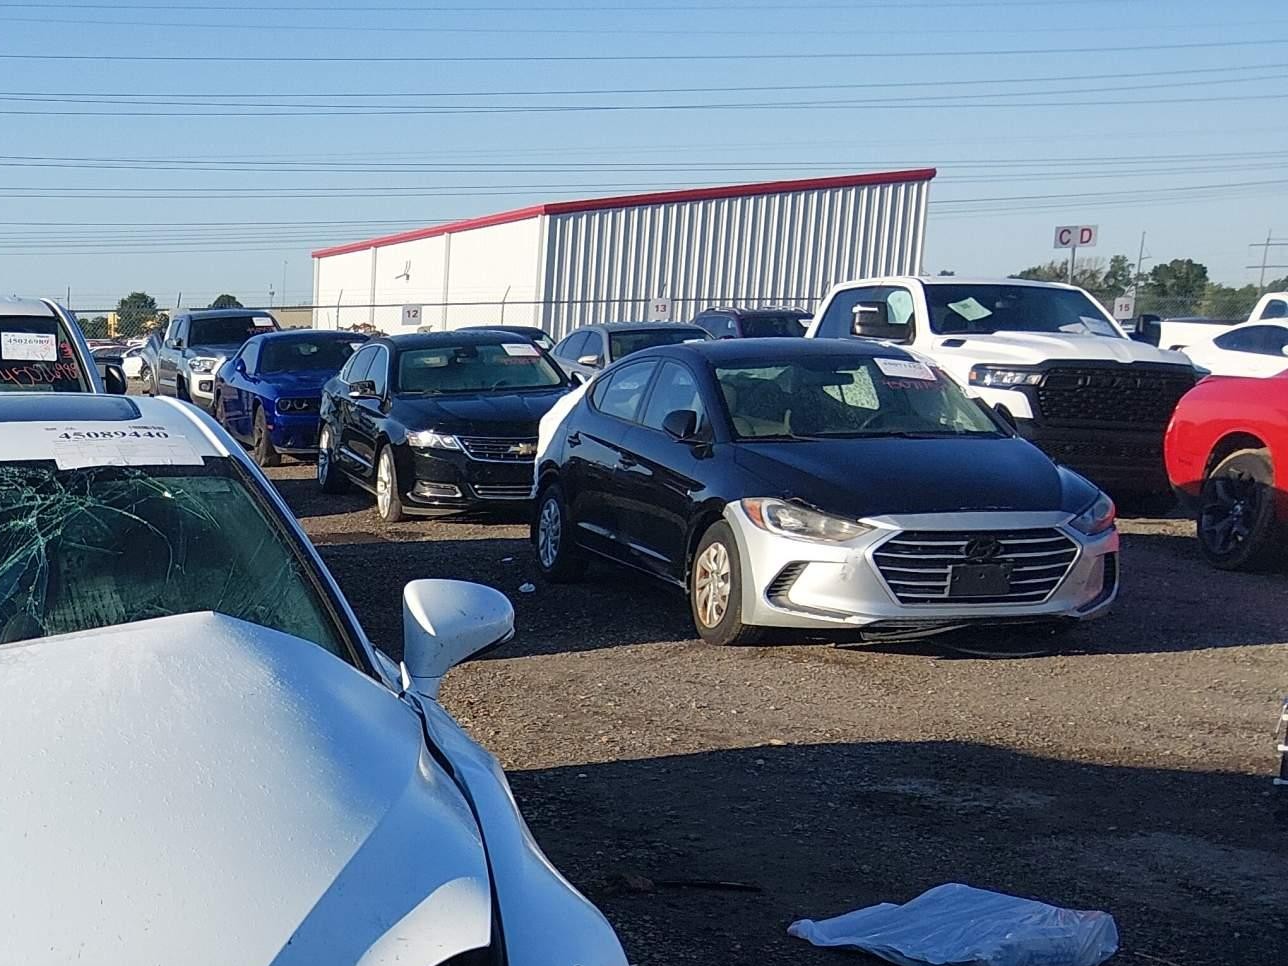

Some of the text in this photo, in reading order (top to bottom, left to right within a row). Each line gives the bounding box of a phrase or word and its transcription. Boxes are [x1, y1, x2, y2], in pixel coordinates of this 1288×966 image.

[1059, 228, 1093, 245] C D
[655, 304, 667, 312] 13
[1119, 303, 1131, 312] 15
[406, 309, 419, 319] 12
[58, 430, 170, 440] 45089440
